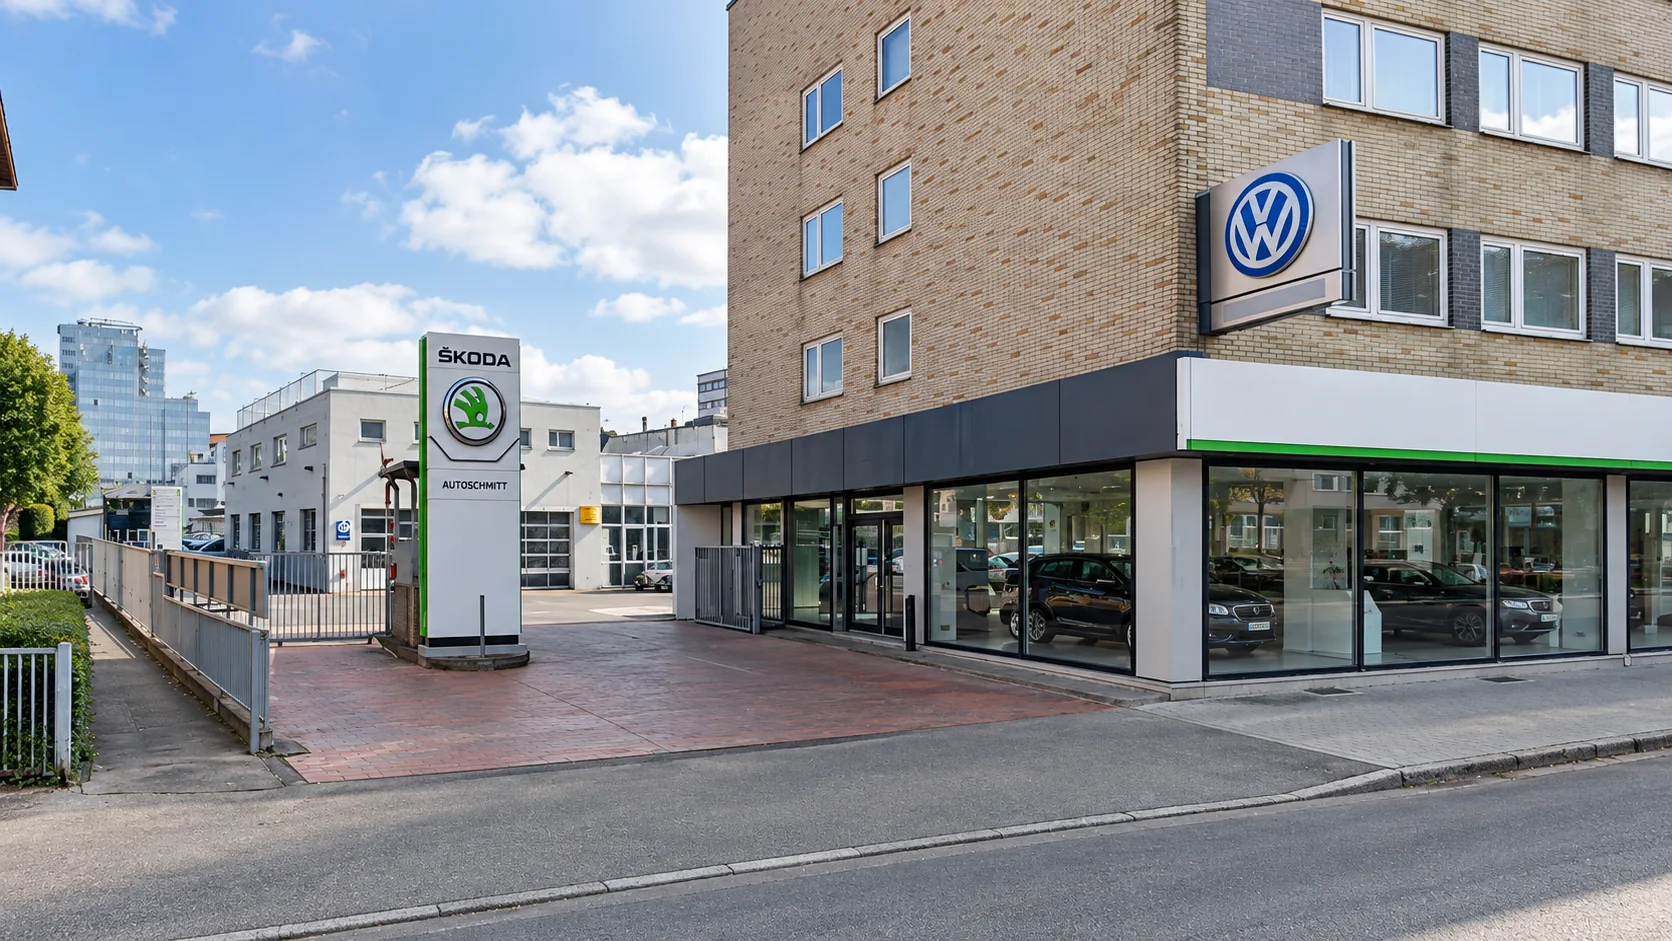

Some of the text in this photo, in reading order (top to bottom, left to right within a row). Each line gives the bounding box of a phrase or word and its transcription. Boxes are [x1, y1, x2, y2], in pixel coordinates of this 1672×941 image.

[1230, 181, 1300, 268] VW
[438, 346, 511, 368] ŠKODA
[442, 480, 508, 490] AUTOSCHMITT
